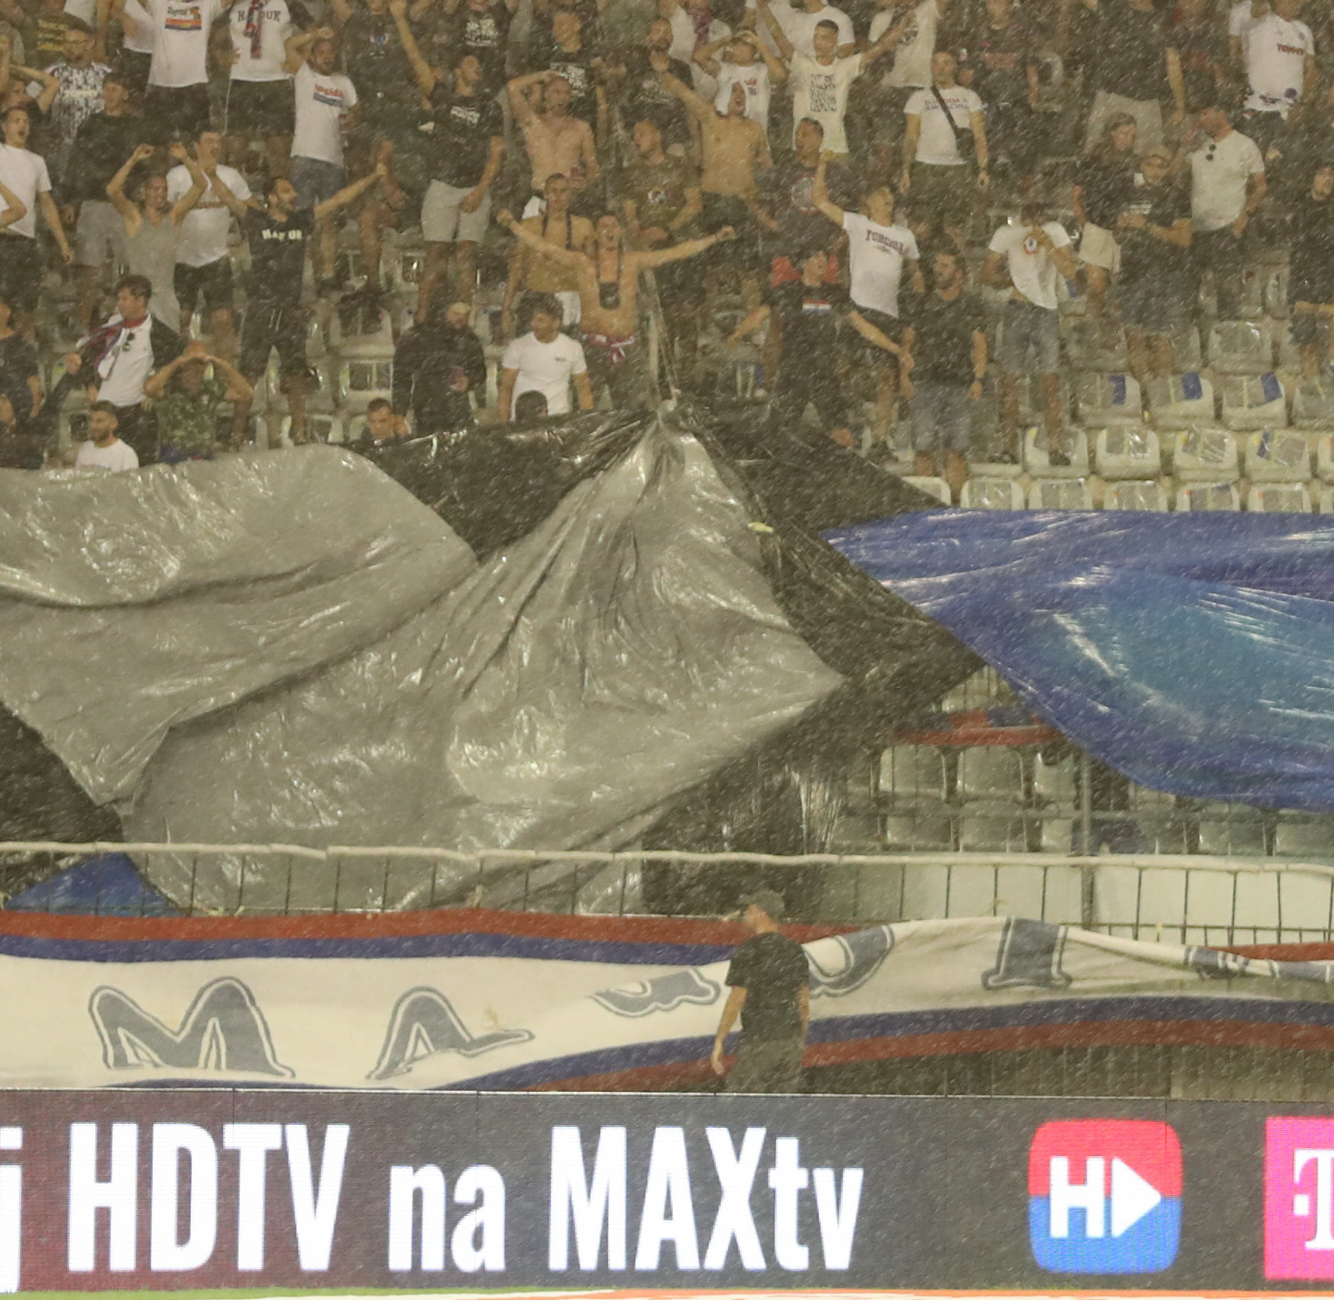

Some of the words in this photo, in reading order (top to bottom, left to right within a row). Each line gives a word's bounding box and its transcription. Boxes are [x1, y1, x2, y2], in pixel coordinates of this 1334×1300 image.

[236, 9, 282, 23] HDUK
[69, 1123, 349, 1272] HDTV
[389, 1164, 505, 1272] na
[549, 1126, 864, 1272] MAXtv
